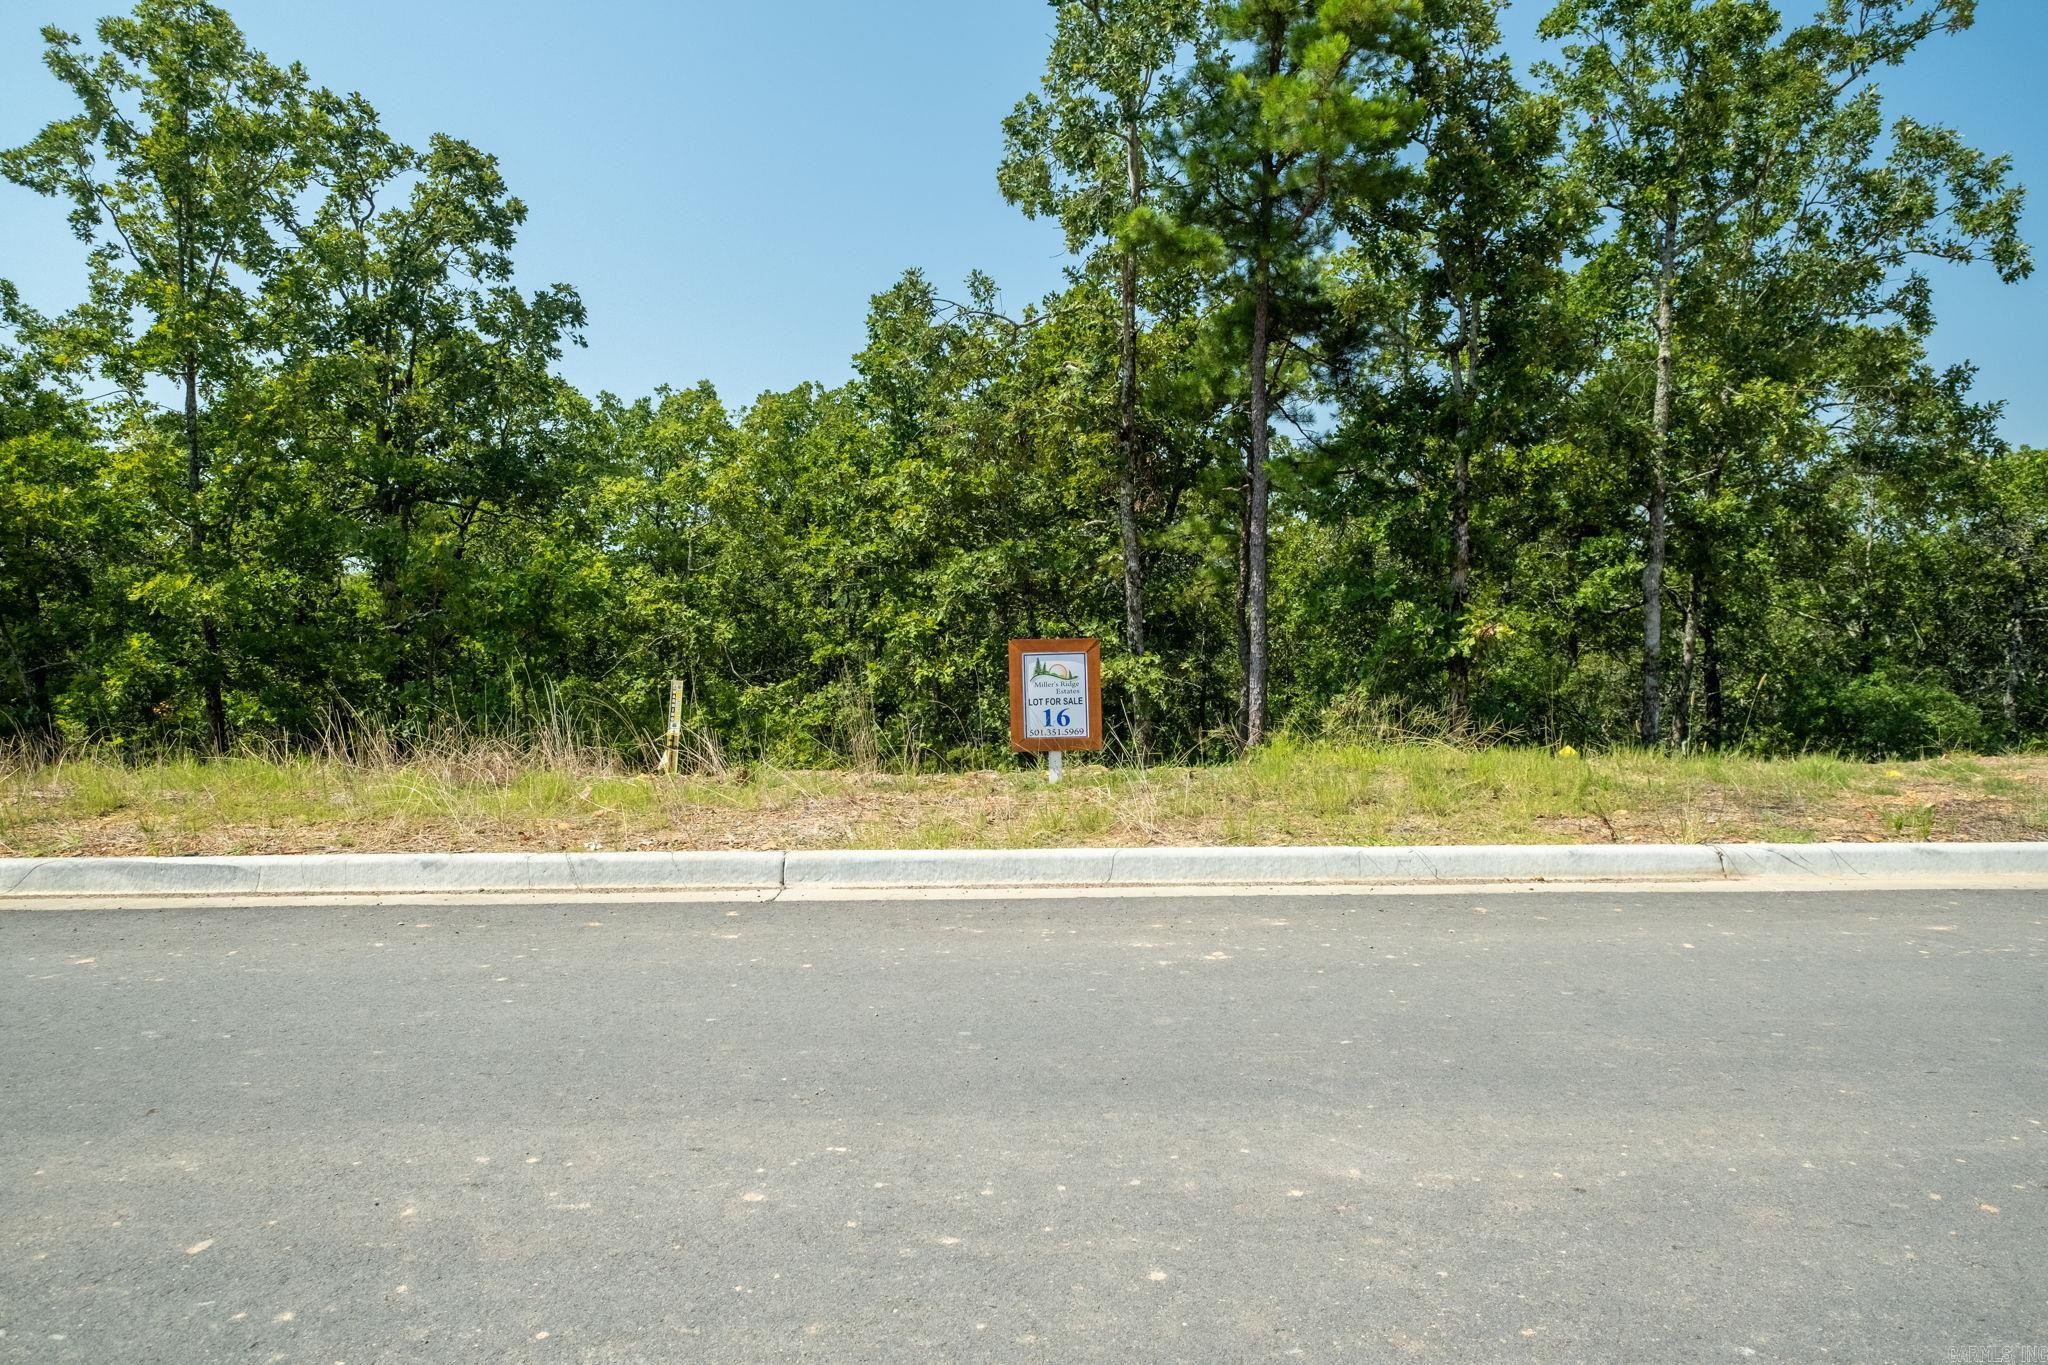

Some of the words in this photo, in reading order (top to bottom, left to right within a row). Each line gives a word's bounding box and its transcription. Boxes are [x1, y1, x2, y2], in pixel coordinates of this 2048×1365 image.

[1060, 680, 1080, 688] Ridge
[1028, 698, 1043, 706] LOT
[1045, 697, 1061, 706] FOR
[1063, 696, 1083, 706] SALE
[1043, 707, 1071, 727] 16
[1029, 727, 1085, 736] 501.351.5969
